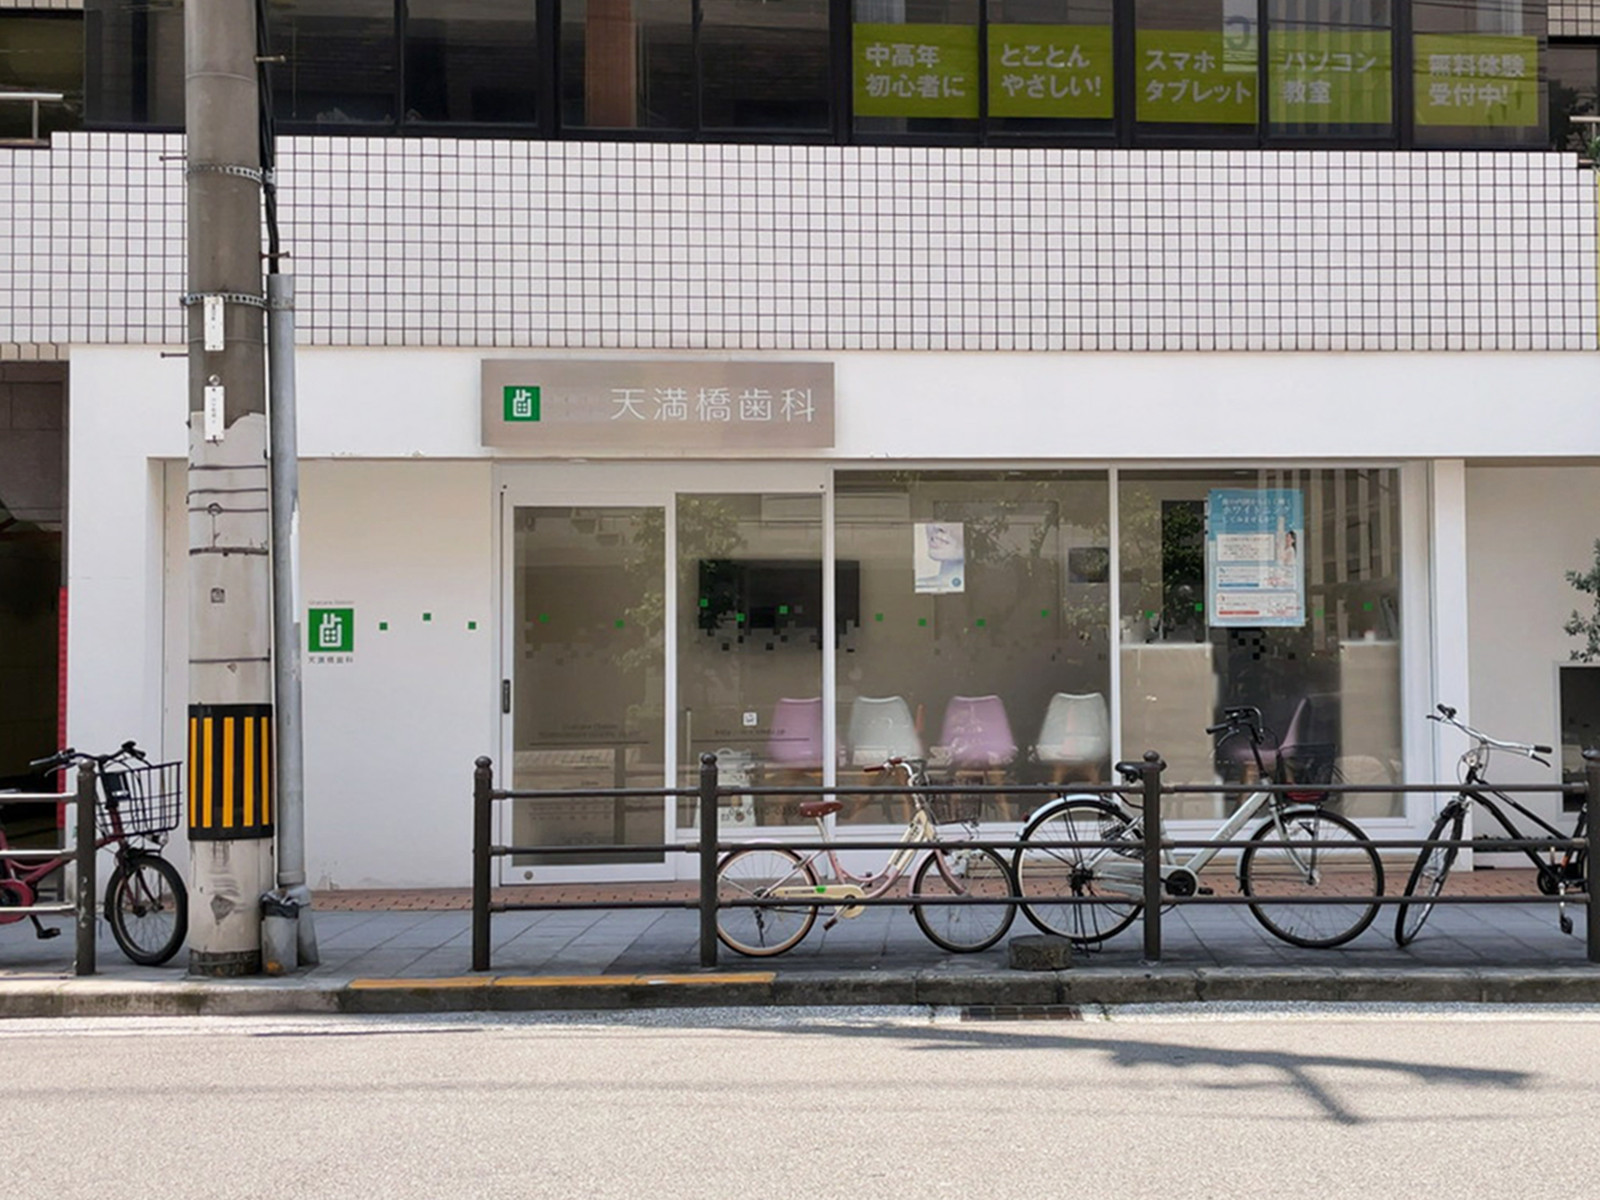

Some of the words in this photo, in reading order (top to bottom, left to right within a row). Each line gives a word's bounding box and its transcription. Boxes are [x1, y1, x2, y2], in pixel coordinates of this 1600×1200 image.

[865, 42, 940, 68] 中高年
[1001, 44, 1090, 68] とことん
[1145, 49, 1216, 72] スマホ
[1283, 51, 1377, 73] パソコン
[1428, 54, 1526, 78] 無料体験
[865, 73, 966, 98] 初心者に
[1001, 74, 1102, 98] やさしい!
[1145, 79, 1251, 104] タブレット
[1284, 80, 1333, 104] 教室
[610, 387, 816, 423] 天満橋歯科
